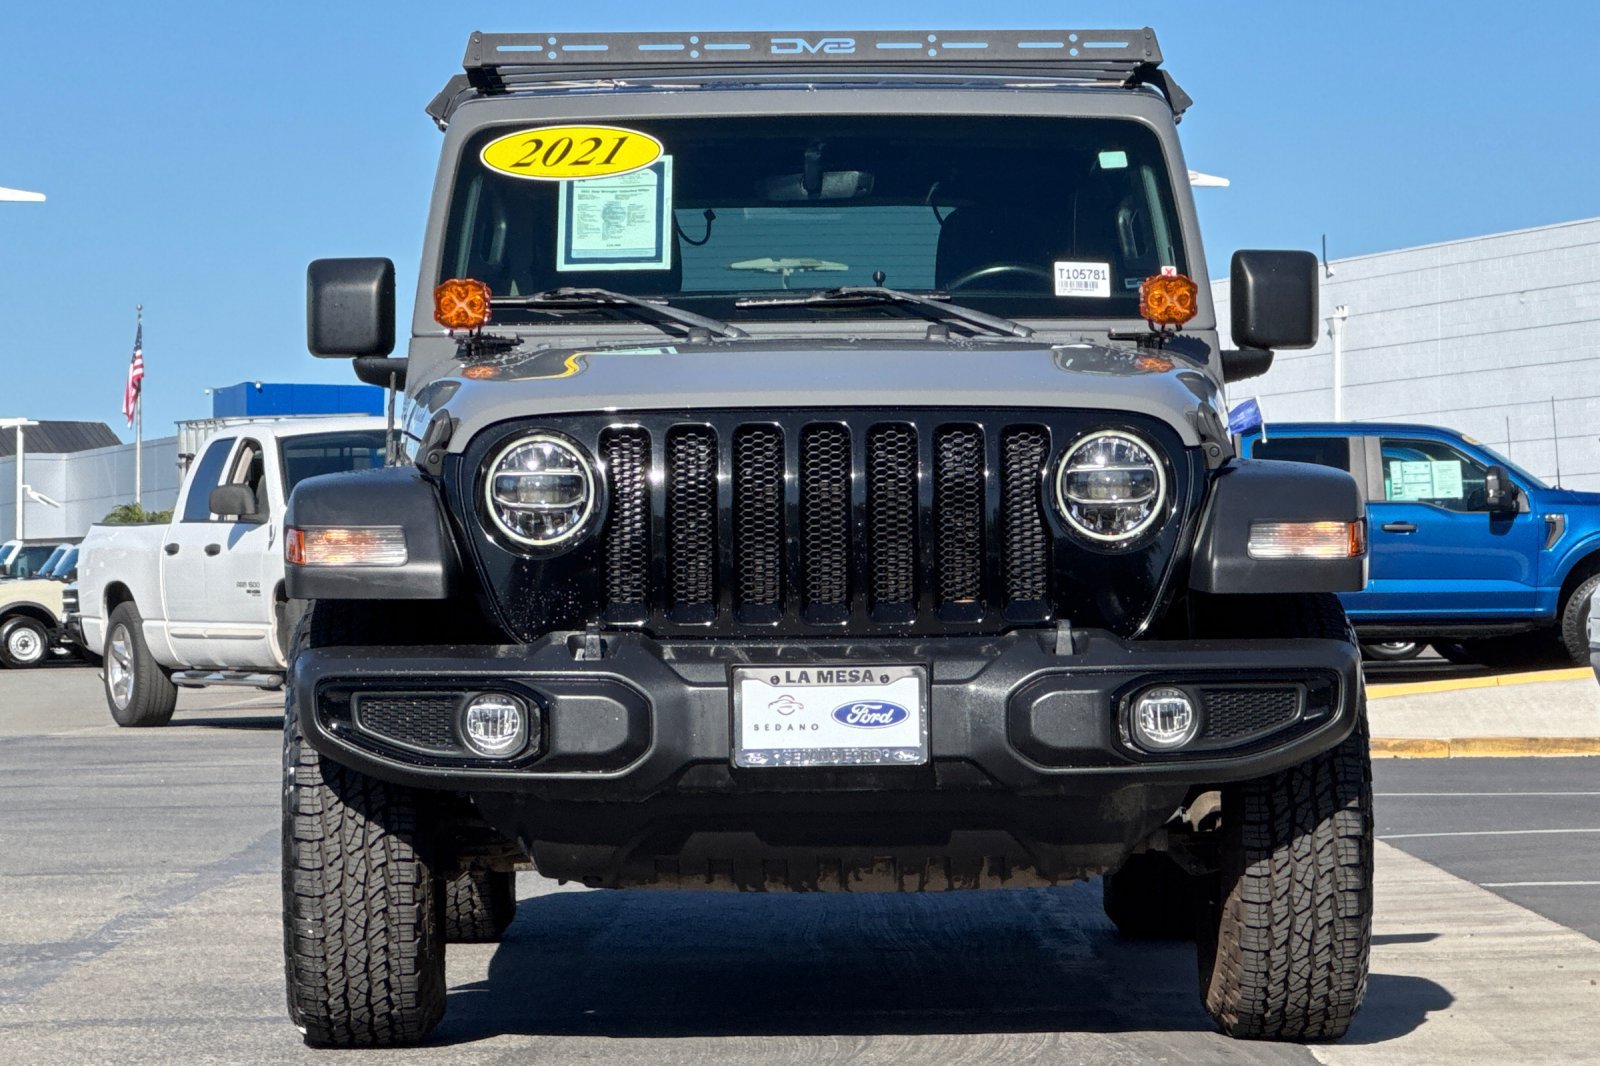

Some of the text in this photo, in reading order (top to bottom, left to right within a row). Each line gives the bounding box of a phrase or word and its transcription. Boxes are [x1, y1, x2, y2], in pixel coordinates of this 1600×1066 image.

[509, 136, 628, 167] 2021
[1058, 268, 1107, 280] T105781
[785, 670, 874, 684] LA MESA
[846, 703, 894, 724] Ford
[753, 723, 820, 731] SEDANO
